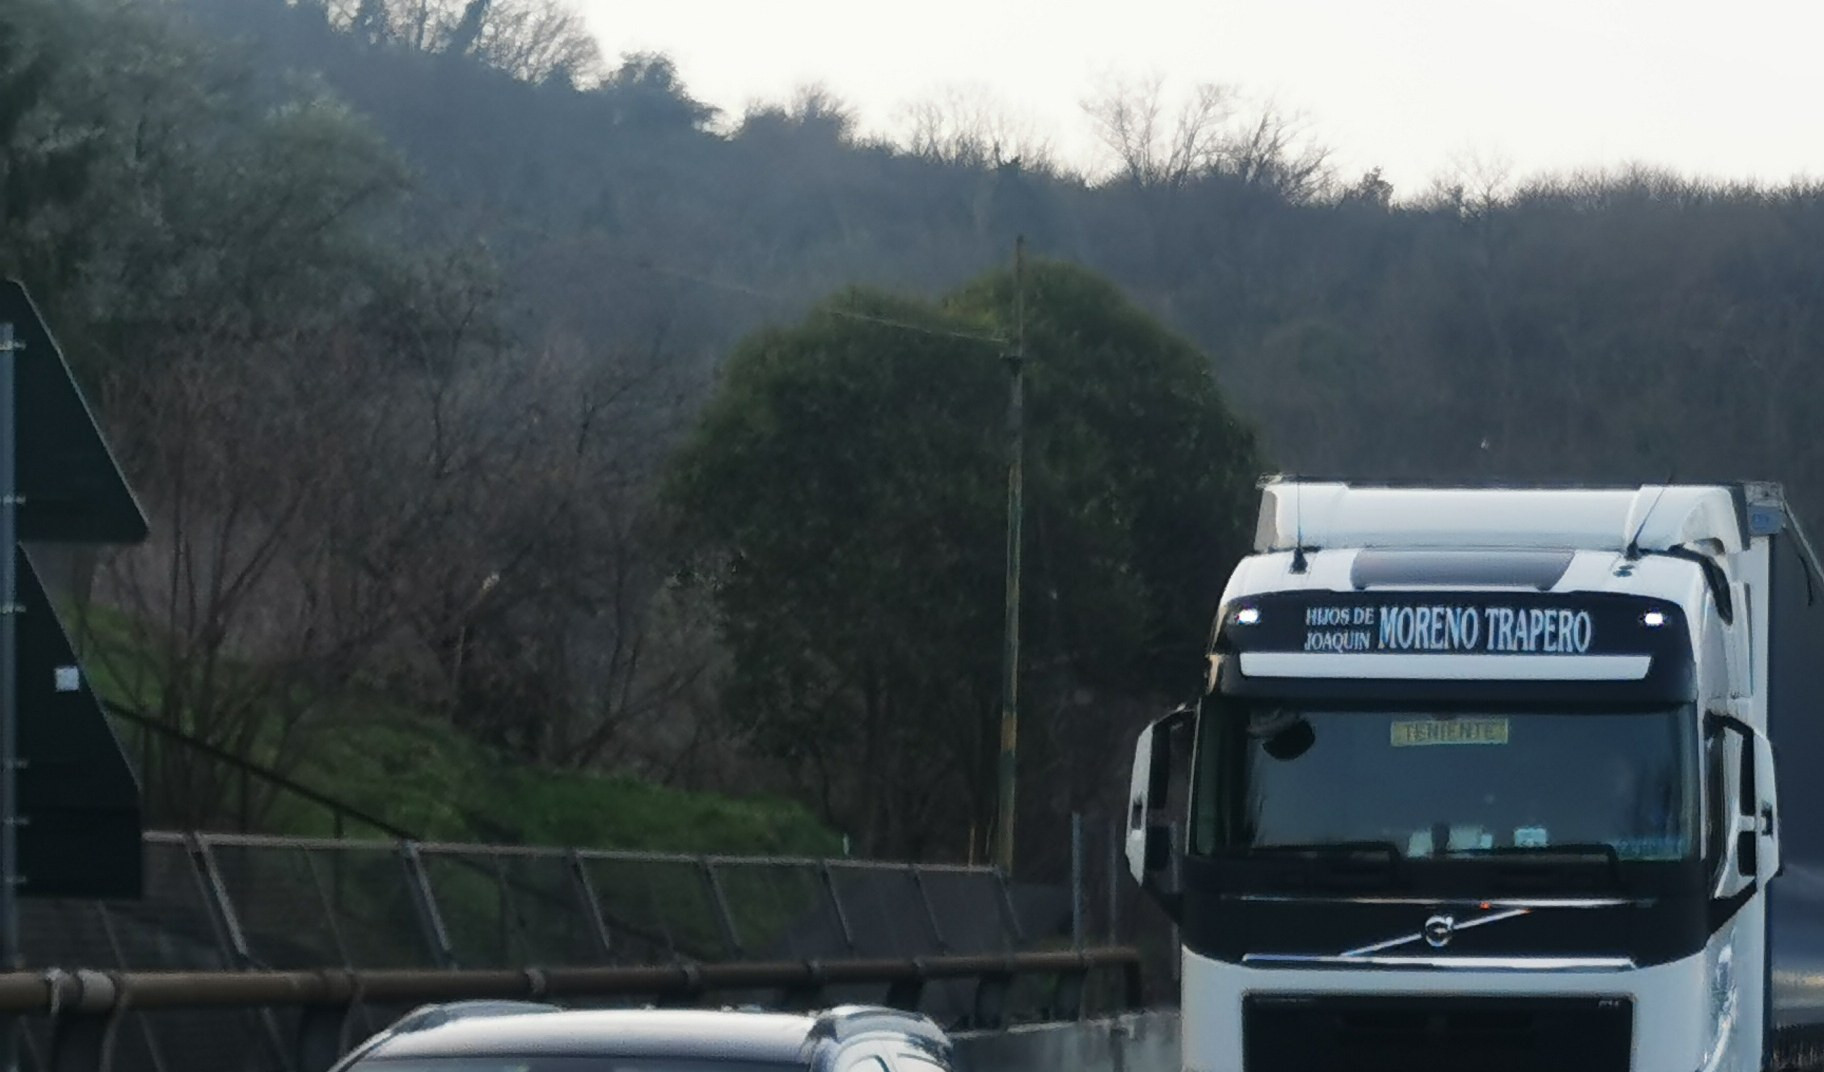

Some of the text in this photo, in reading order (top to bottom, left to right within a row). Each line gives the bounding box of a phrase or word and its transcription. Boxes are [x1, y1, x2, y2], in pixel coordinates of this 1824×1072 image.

[1305, 607, 1375, 626] HIJOS DE
[1378, 606, 1592, 653] MORENO TRAPERO
[1304, 632, 1371, 653] JOAQUIN
